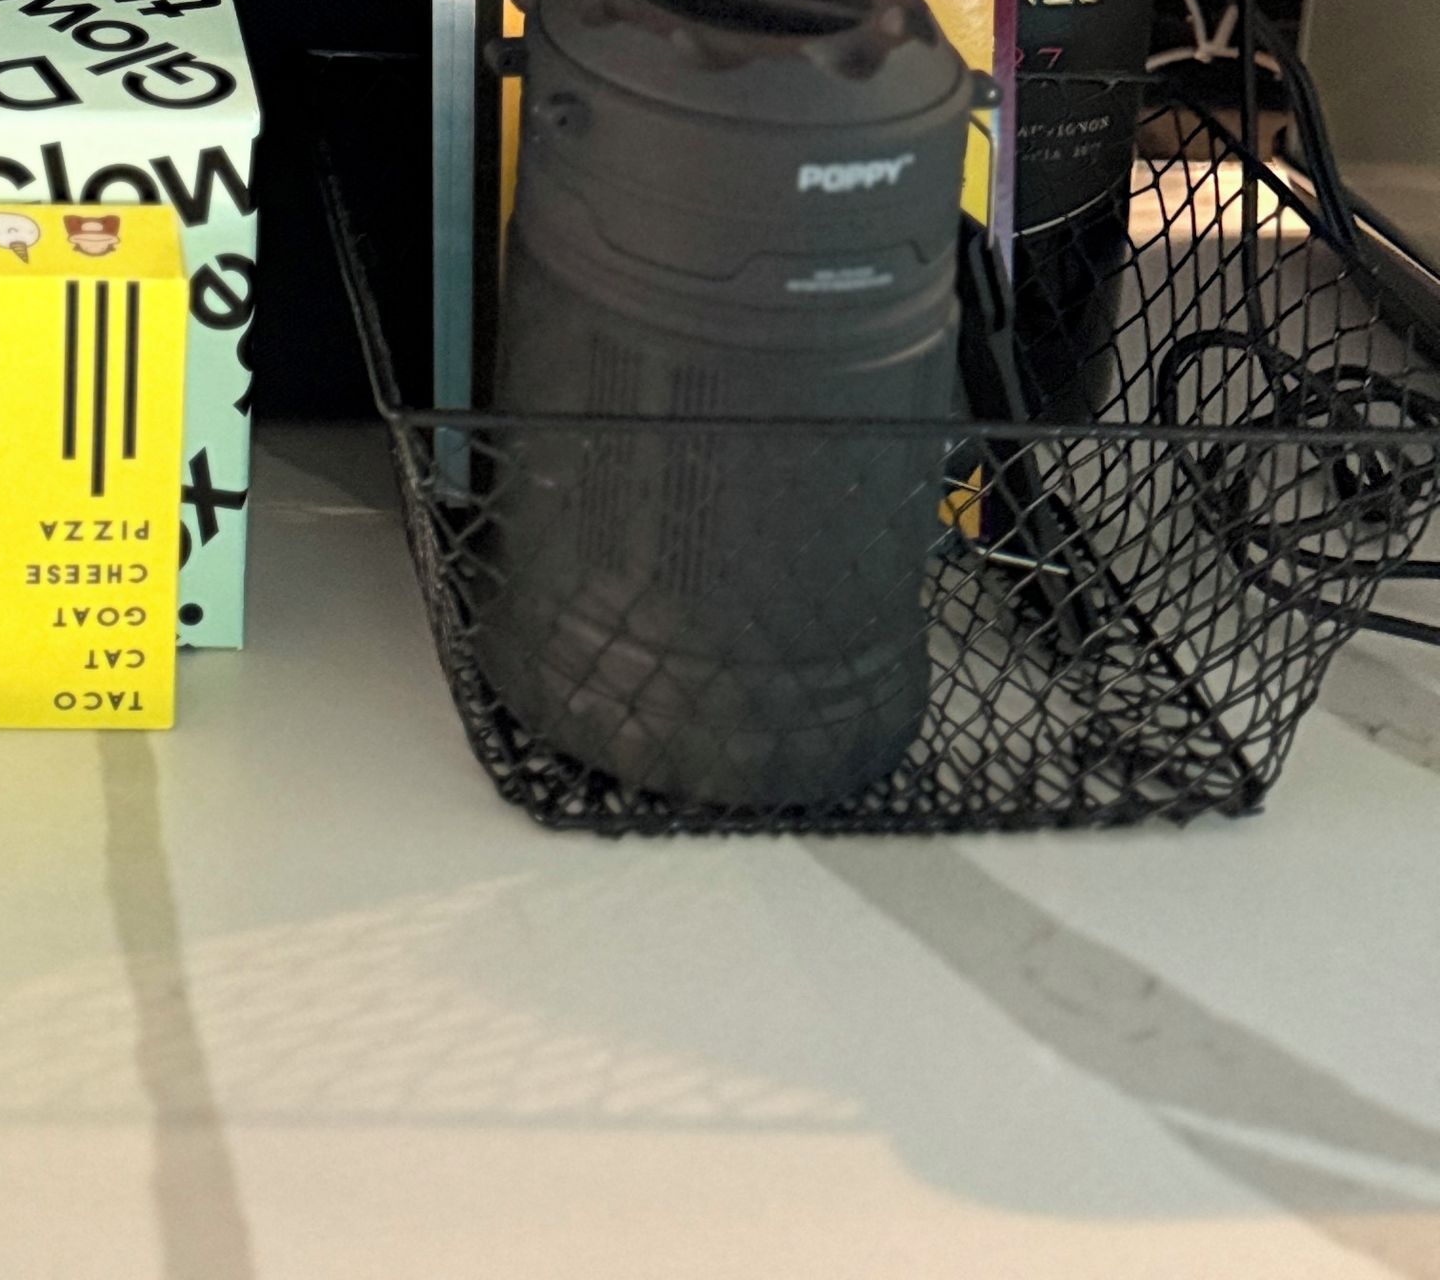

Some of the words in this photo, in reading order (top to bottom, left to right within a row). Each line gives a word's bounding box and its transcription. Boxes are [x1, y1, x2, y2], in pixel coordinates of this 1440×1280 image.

[39, 520, 150, 541] PIZZA
[25, 563, 148, 584] CHEESE
[52, 607, 147, 627] GOAT
[84, 649, 146, 669] CAT
[53, 691, 144, 711] TACO
